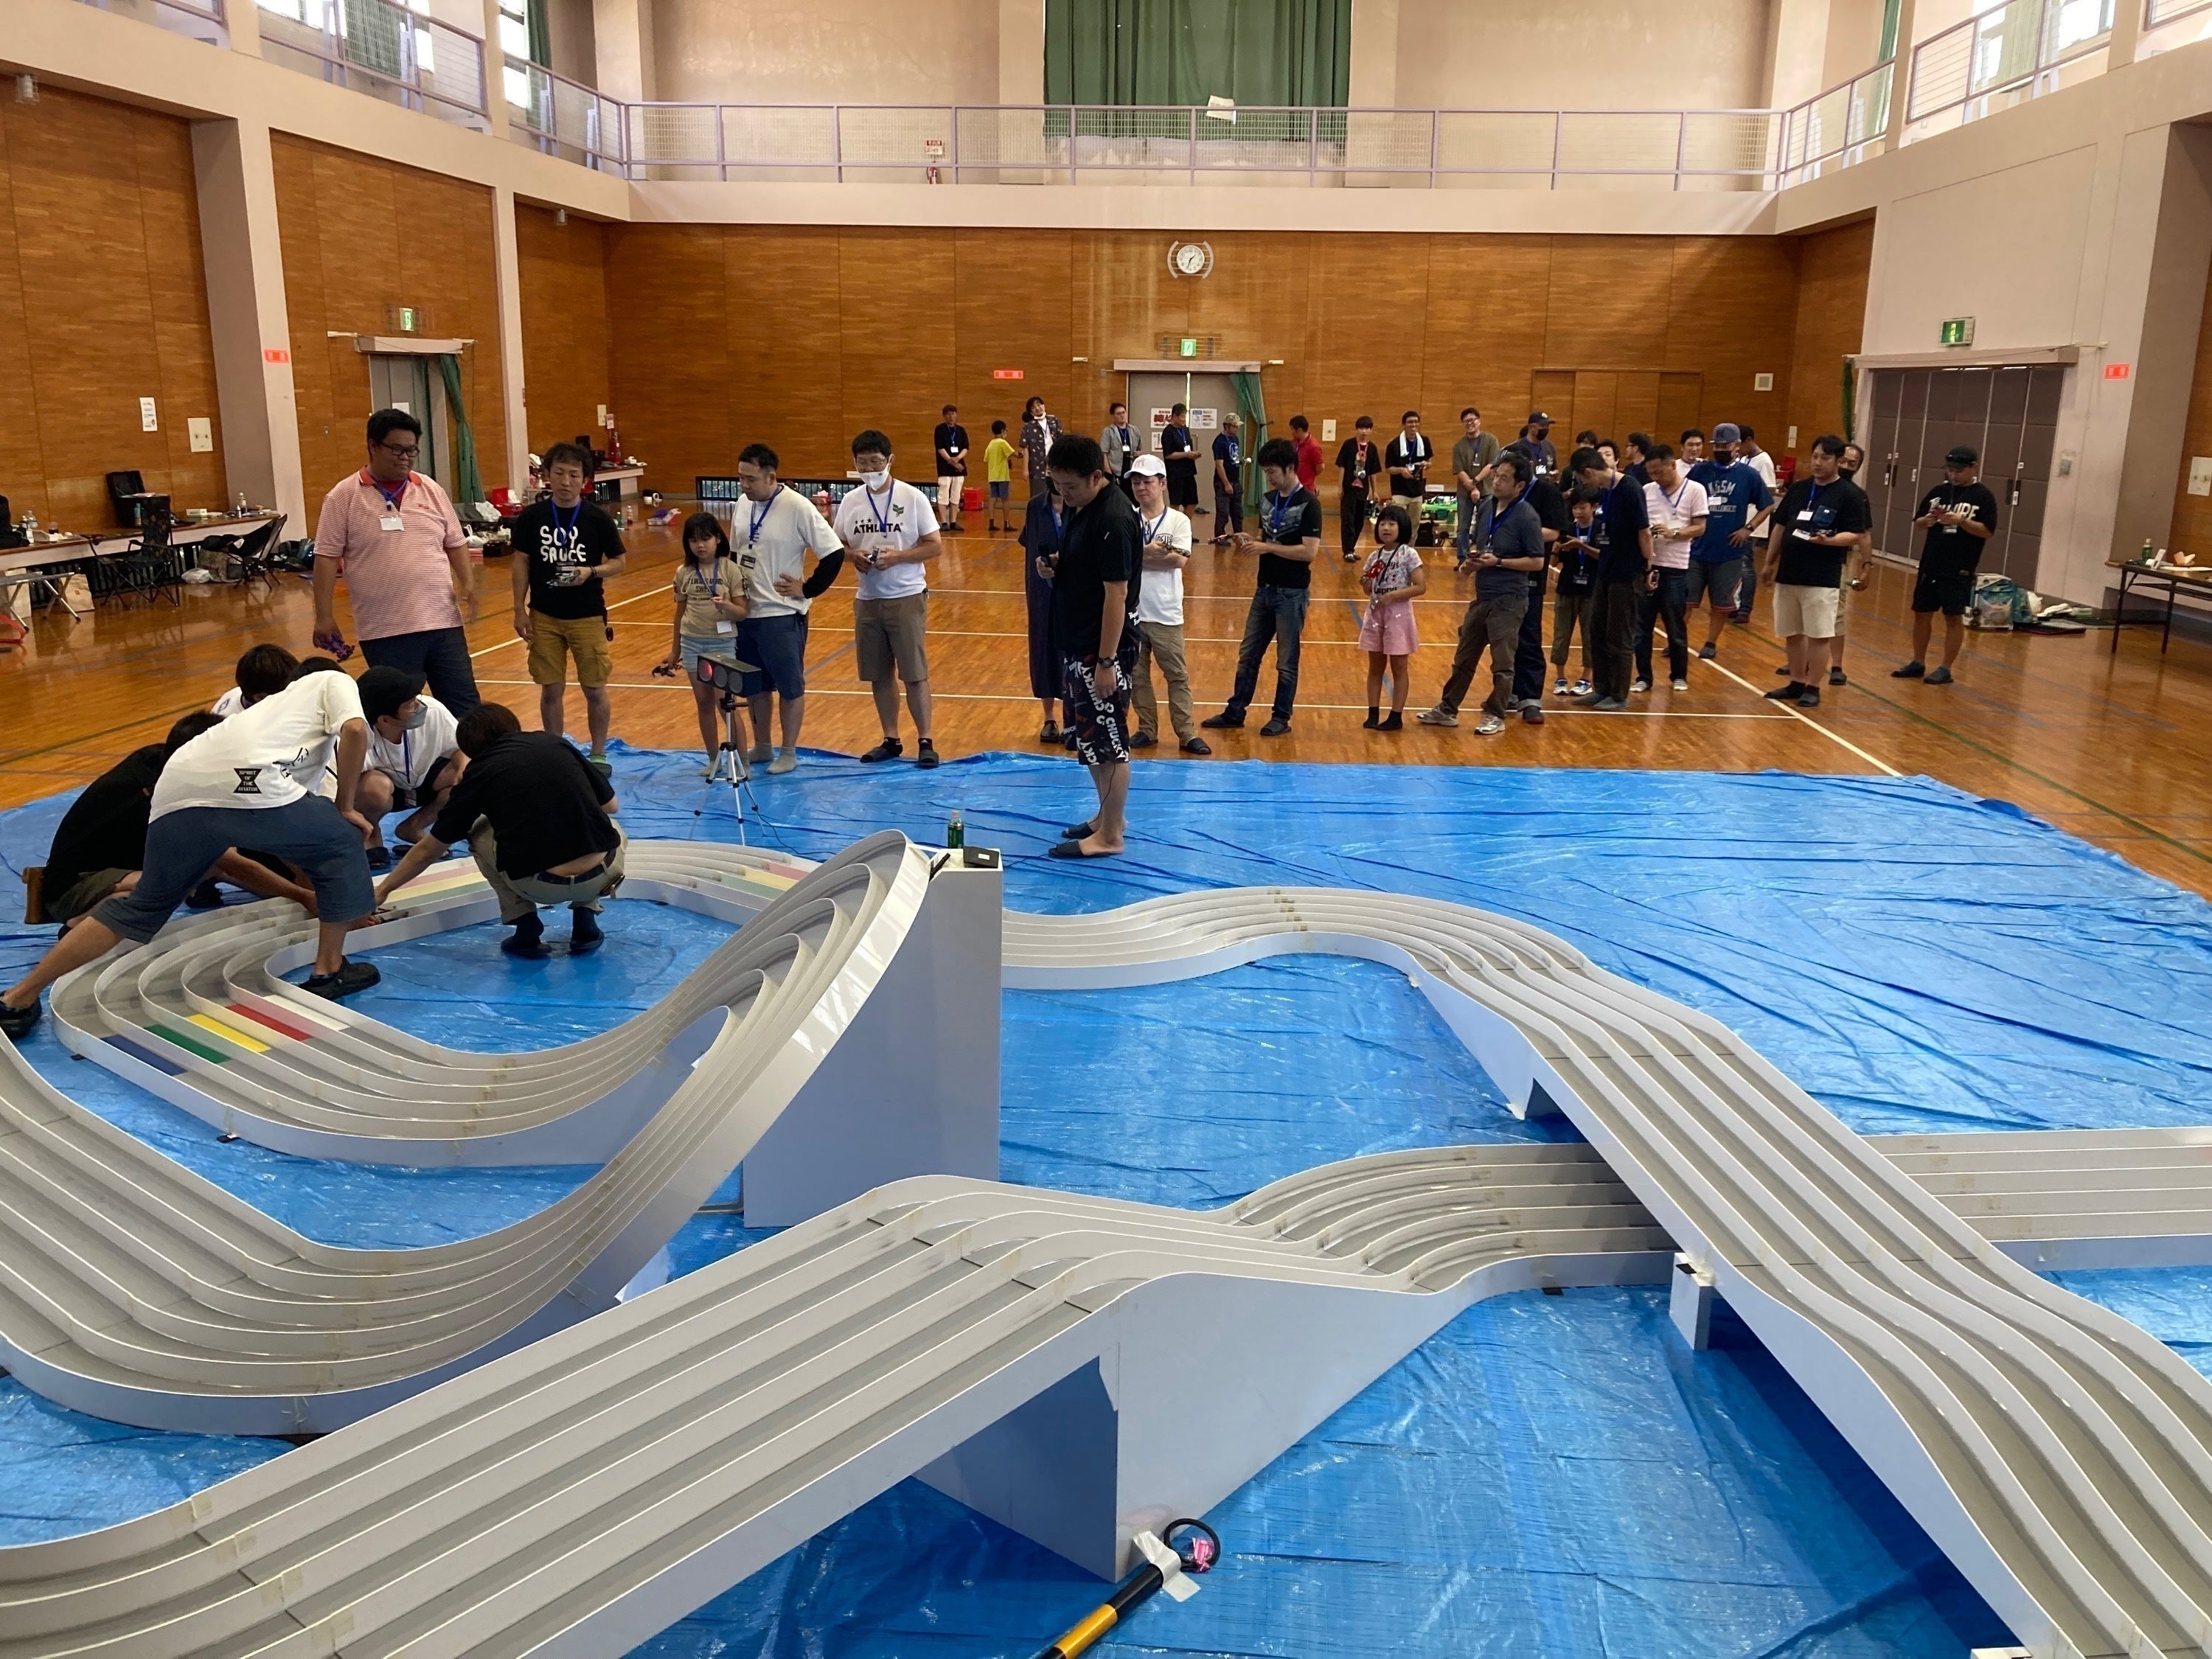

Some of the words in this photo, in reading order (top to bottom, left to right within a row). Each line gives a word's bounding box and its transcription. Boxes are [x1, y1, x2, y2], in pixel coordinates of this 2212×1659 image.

[540, 525, 579, 549] SOY
[853, 523, 902, 535] ATHLTA
[540, 543, 587, 564] SAUCE
[1106, 717, 1129, 762] CHUCKY
